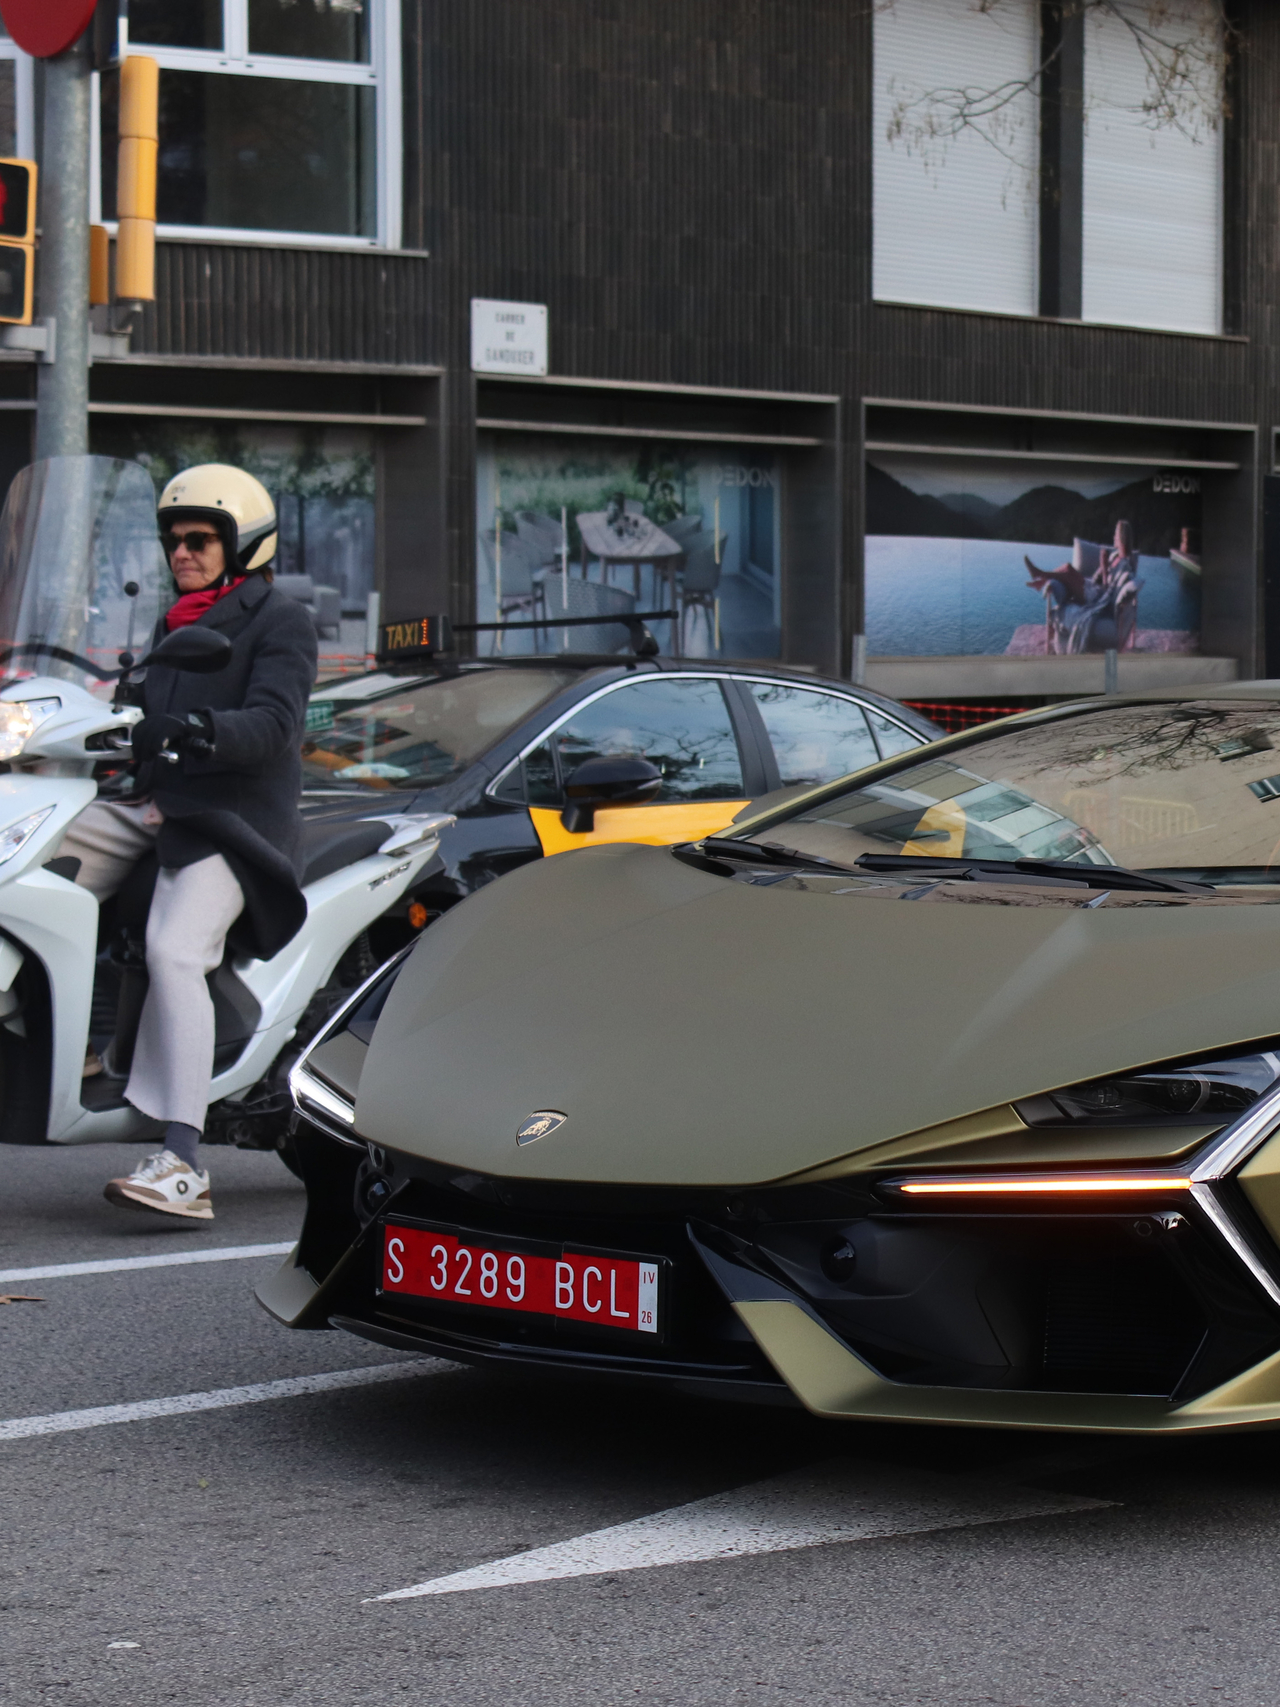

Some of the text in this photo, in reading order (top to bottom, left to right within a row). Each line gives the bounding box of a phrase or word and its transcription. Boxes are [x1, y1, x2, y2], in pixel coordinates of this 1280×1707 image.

[1152, 473, 1201, 494] DEDON
[386, 618, 429, 650] TAXI 1
[387, 1237, 630, 1318] S 3289 BCL
[643, 1271, 656, 1285] IV
[641, 1310, 653, 1324] 26
